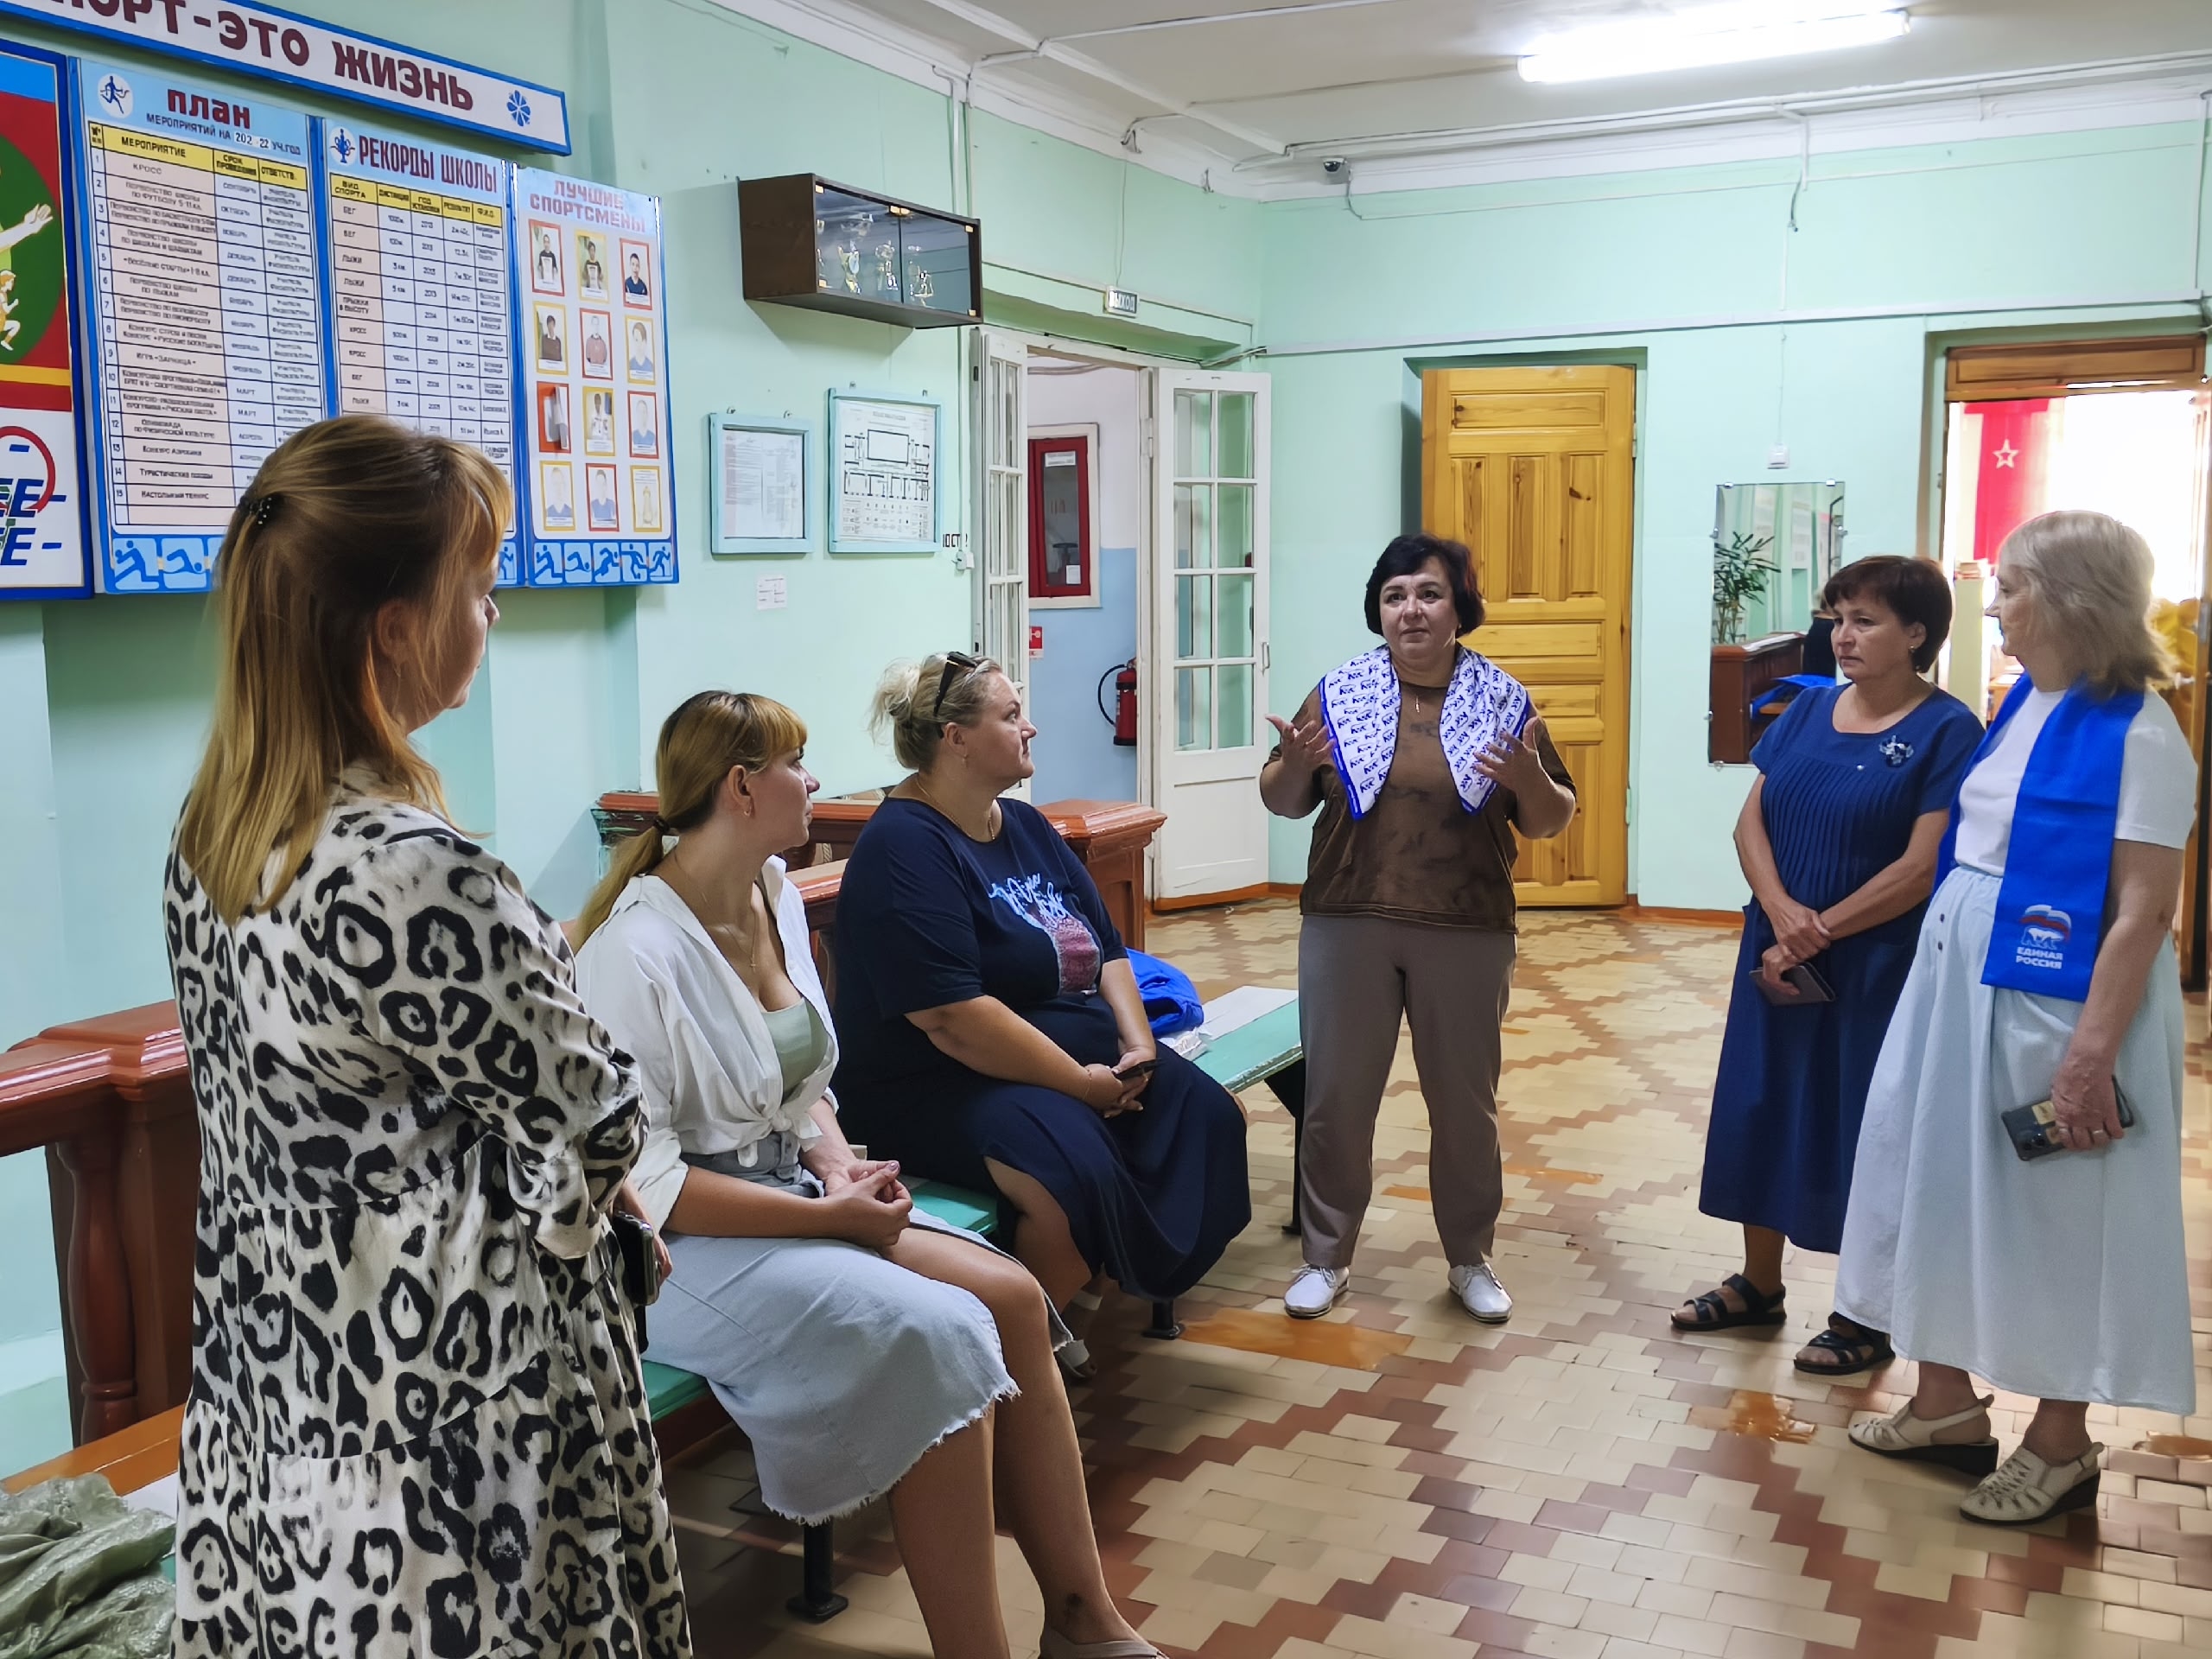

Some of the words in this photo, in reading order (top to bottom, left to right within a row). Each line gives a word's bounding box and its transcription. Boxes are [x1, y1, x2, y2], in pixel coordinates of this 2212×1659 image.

[50, 0, 309, 67] ОРТ-ЭТО
[334, 41, 474, 111] ЖИЗНЬ
[147, 113, 217, 137] МЕРОПРИЯТИЙ
[219, 130, 232, 140] НА
[120, 135, 187, 159] МЕРОПРИЯТИЕ
[222, 153, 243, 165] СРОК
[359, 135, 435, 180] РЕКОРДЫ
[441, 154, 499, 194] ШКОЛЫ
[132, 162, 162, 175] КРОСС
[334, 185, 366, 199] СПОРТА
[341, 180, 359, 190] ВИД
[417, 195, 431, 205] ГОД
[554, 180, 624, 210] ЛУЧШИЕ
[529, 193, 646, 233] СПОРТСМЕНЫ
[2016, 946, 2064, 961] ЕДИНАЯ
[2015, 955, 2063, 969] РОССИЯ
